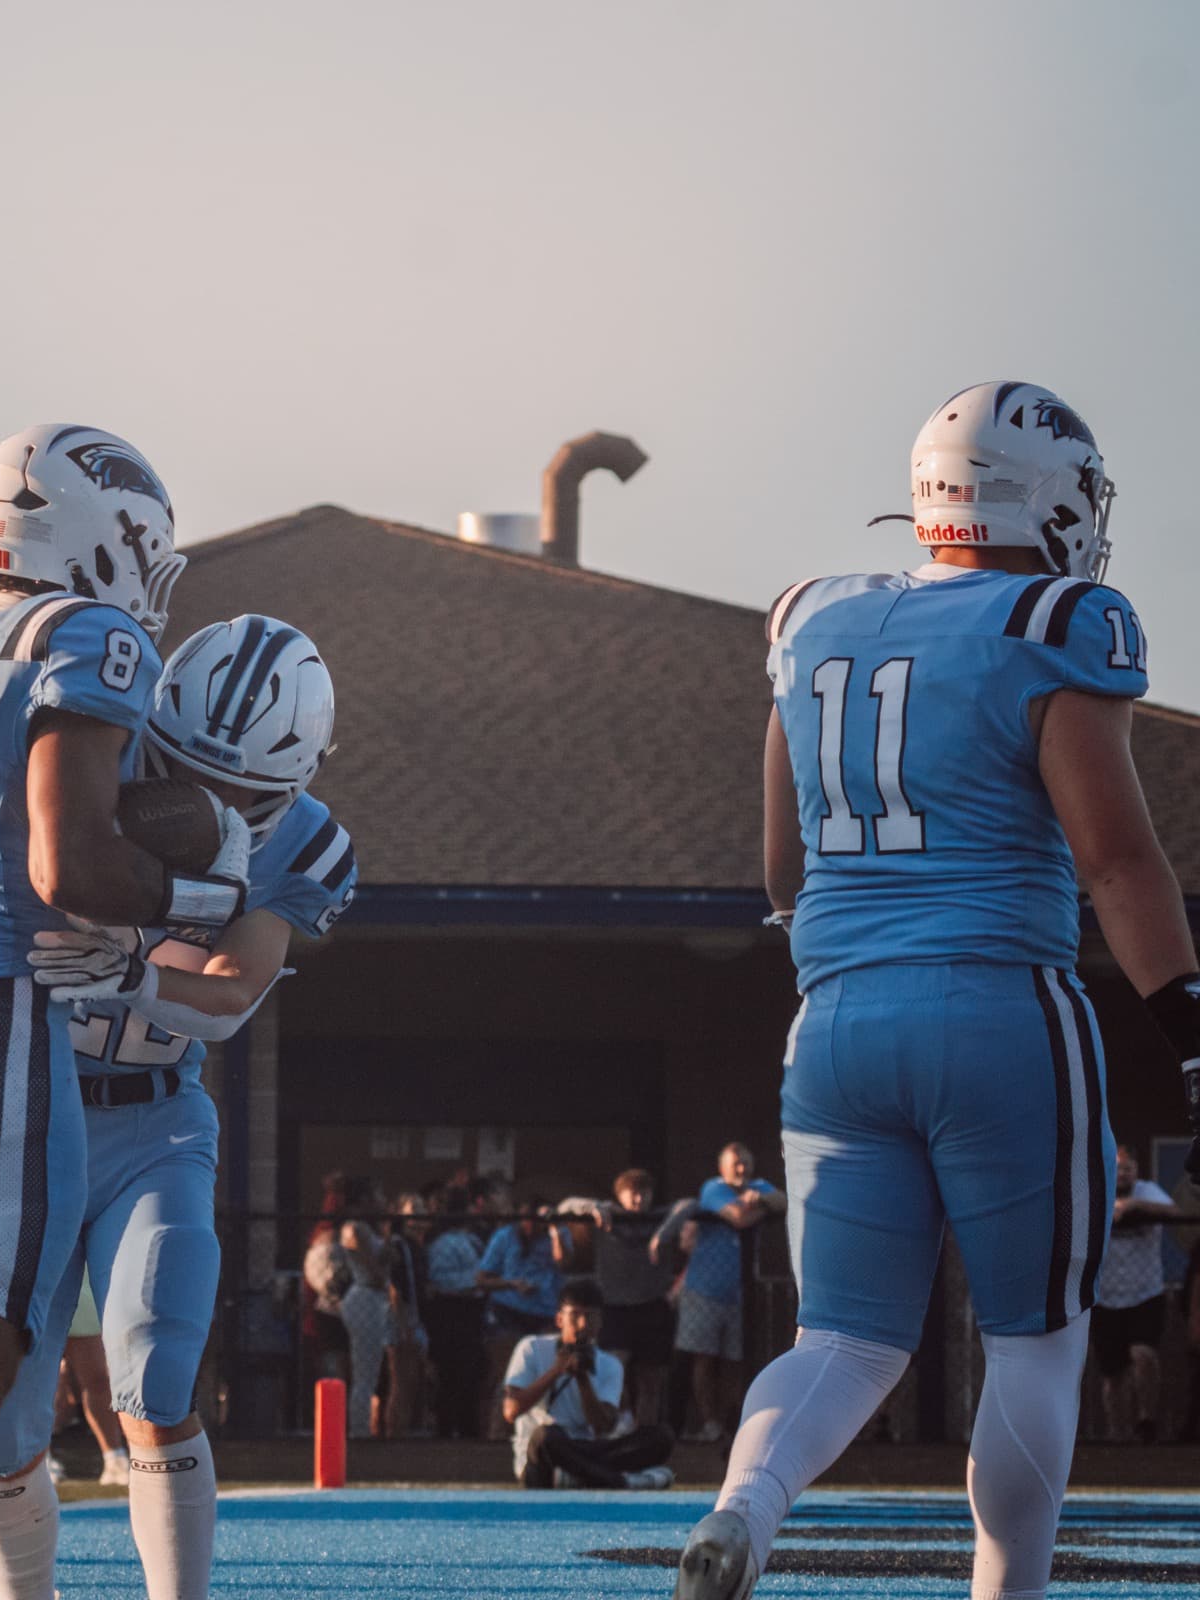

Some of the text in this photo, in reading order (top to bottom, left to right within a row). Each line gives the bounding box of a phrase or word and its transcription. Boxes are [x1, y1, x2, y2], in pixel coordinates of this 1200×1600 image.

[920, 481, 931, 498] 11
[916, 523, 989, 542] Riddell
[98, 628, 142, 693] 8
[1103, 606, 1147, 675] 11
[812, 656, 926, 856] 11
